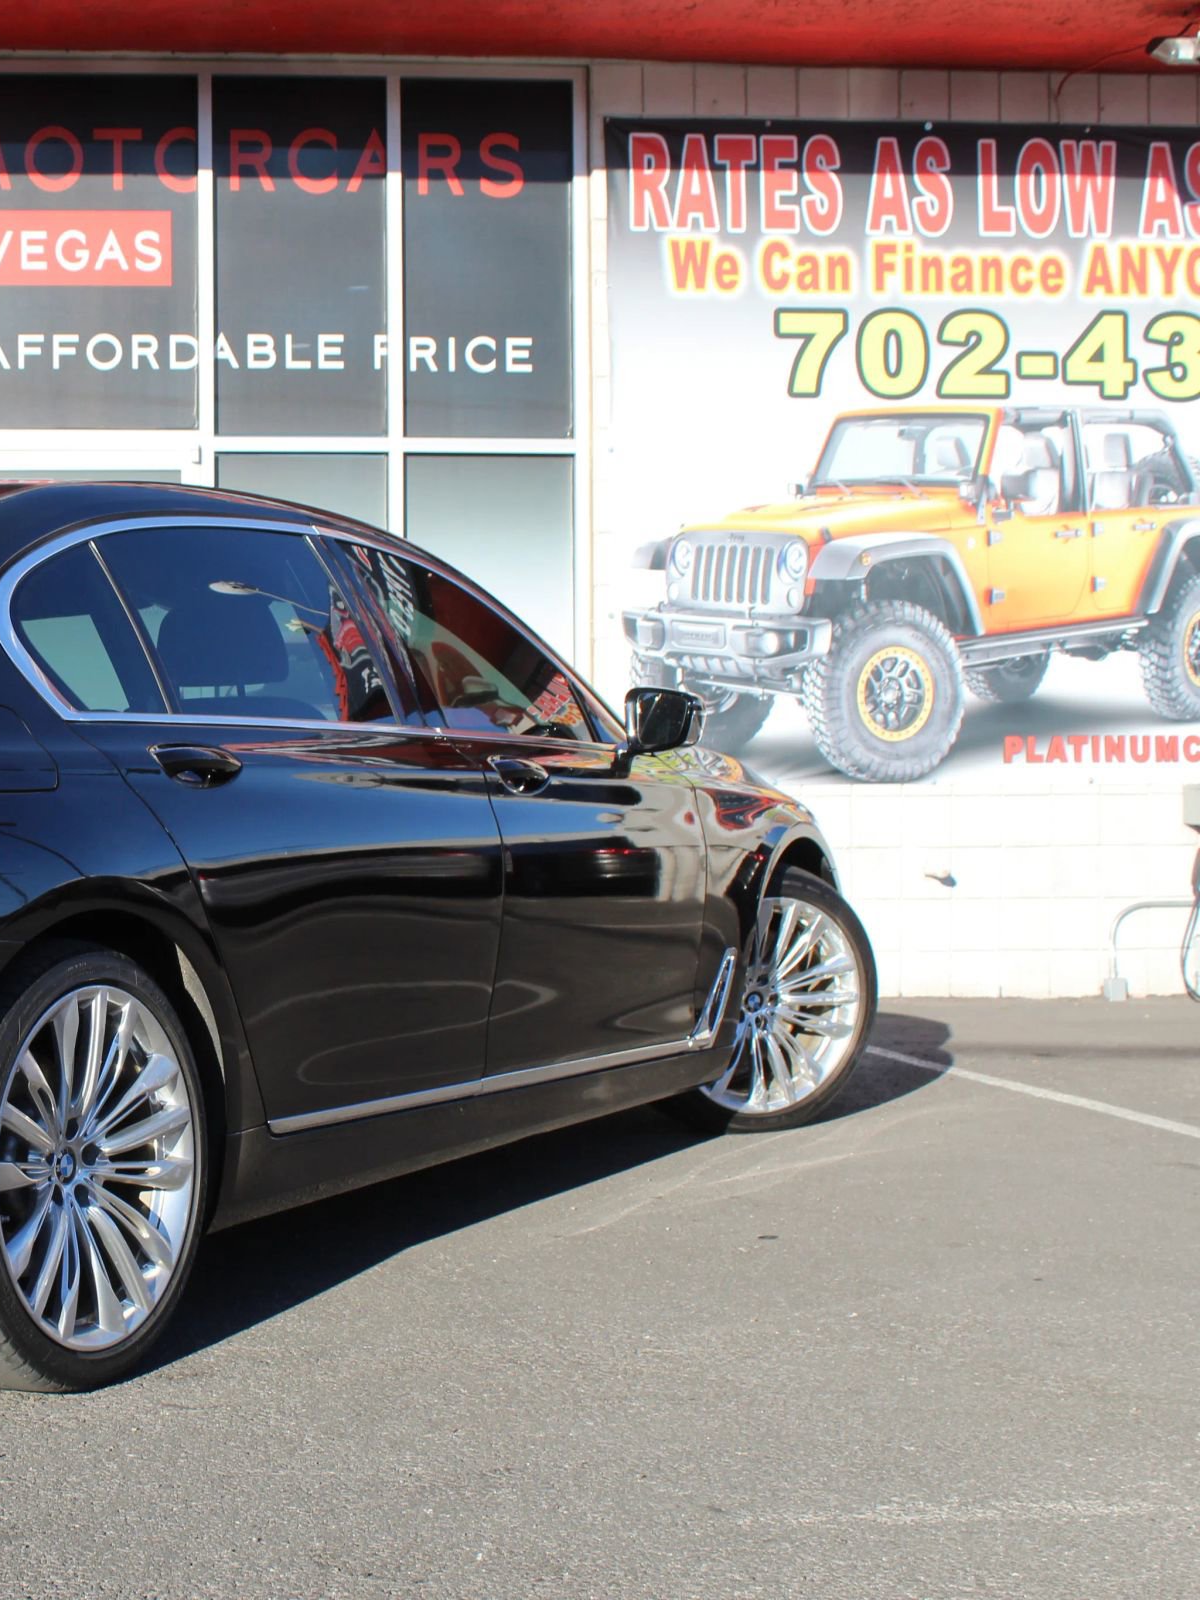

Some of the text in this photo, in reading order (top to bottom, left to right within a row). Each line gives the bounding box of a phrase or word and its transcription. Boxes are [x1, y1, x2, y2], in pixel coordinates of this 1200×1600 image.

[627, 132, 843, 236] RATES
[866, 136, 953, 238] AS
[978, 138, 1116, 239] LOW
[669, 240, 740, 292] We
[760, 240, 851, 293] Can
[872, 242, 1065, 294] Finance
[773, 308, 1200, 402] 702-43
[1003, 735, 1200, 764] PLATINUMC
